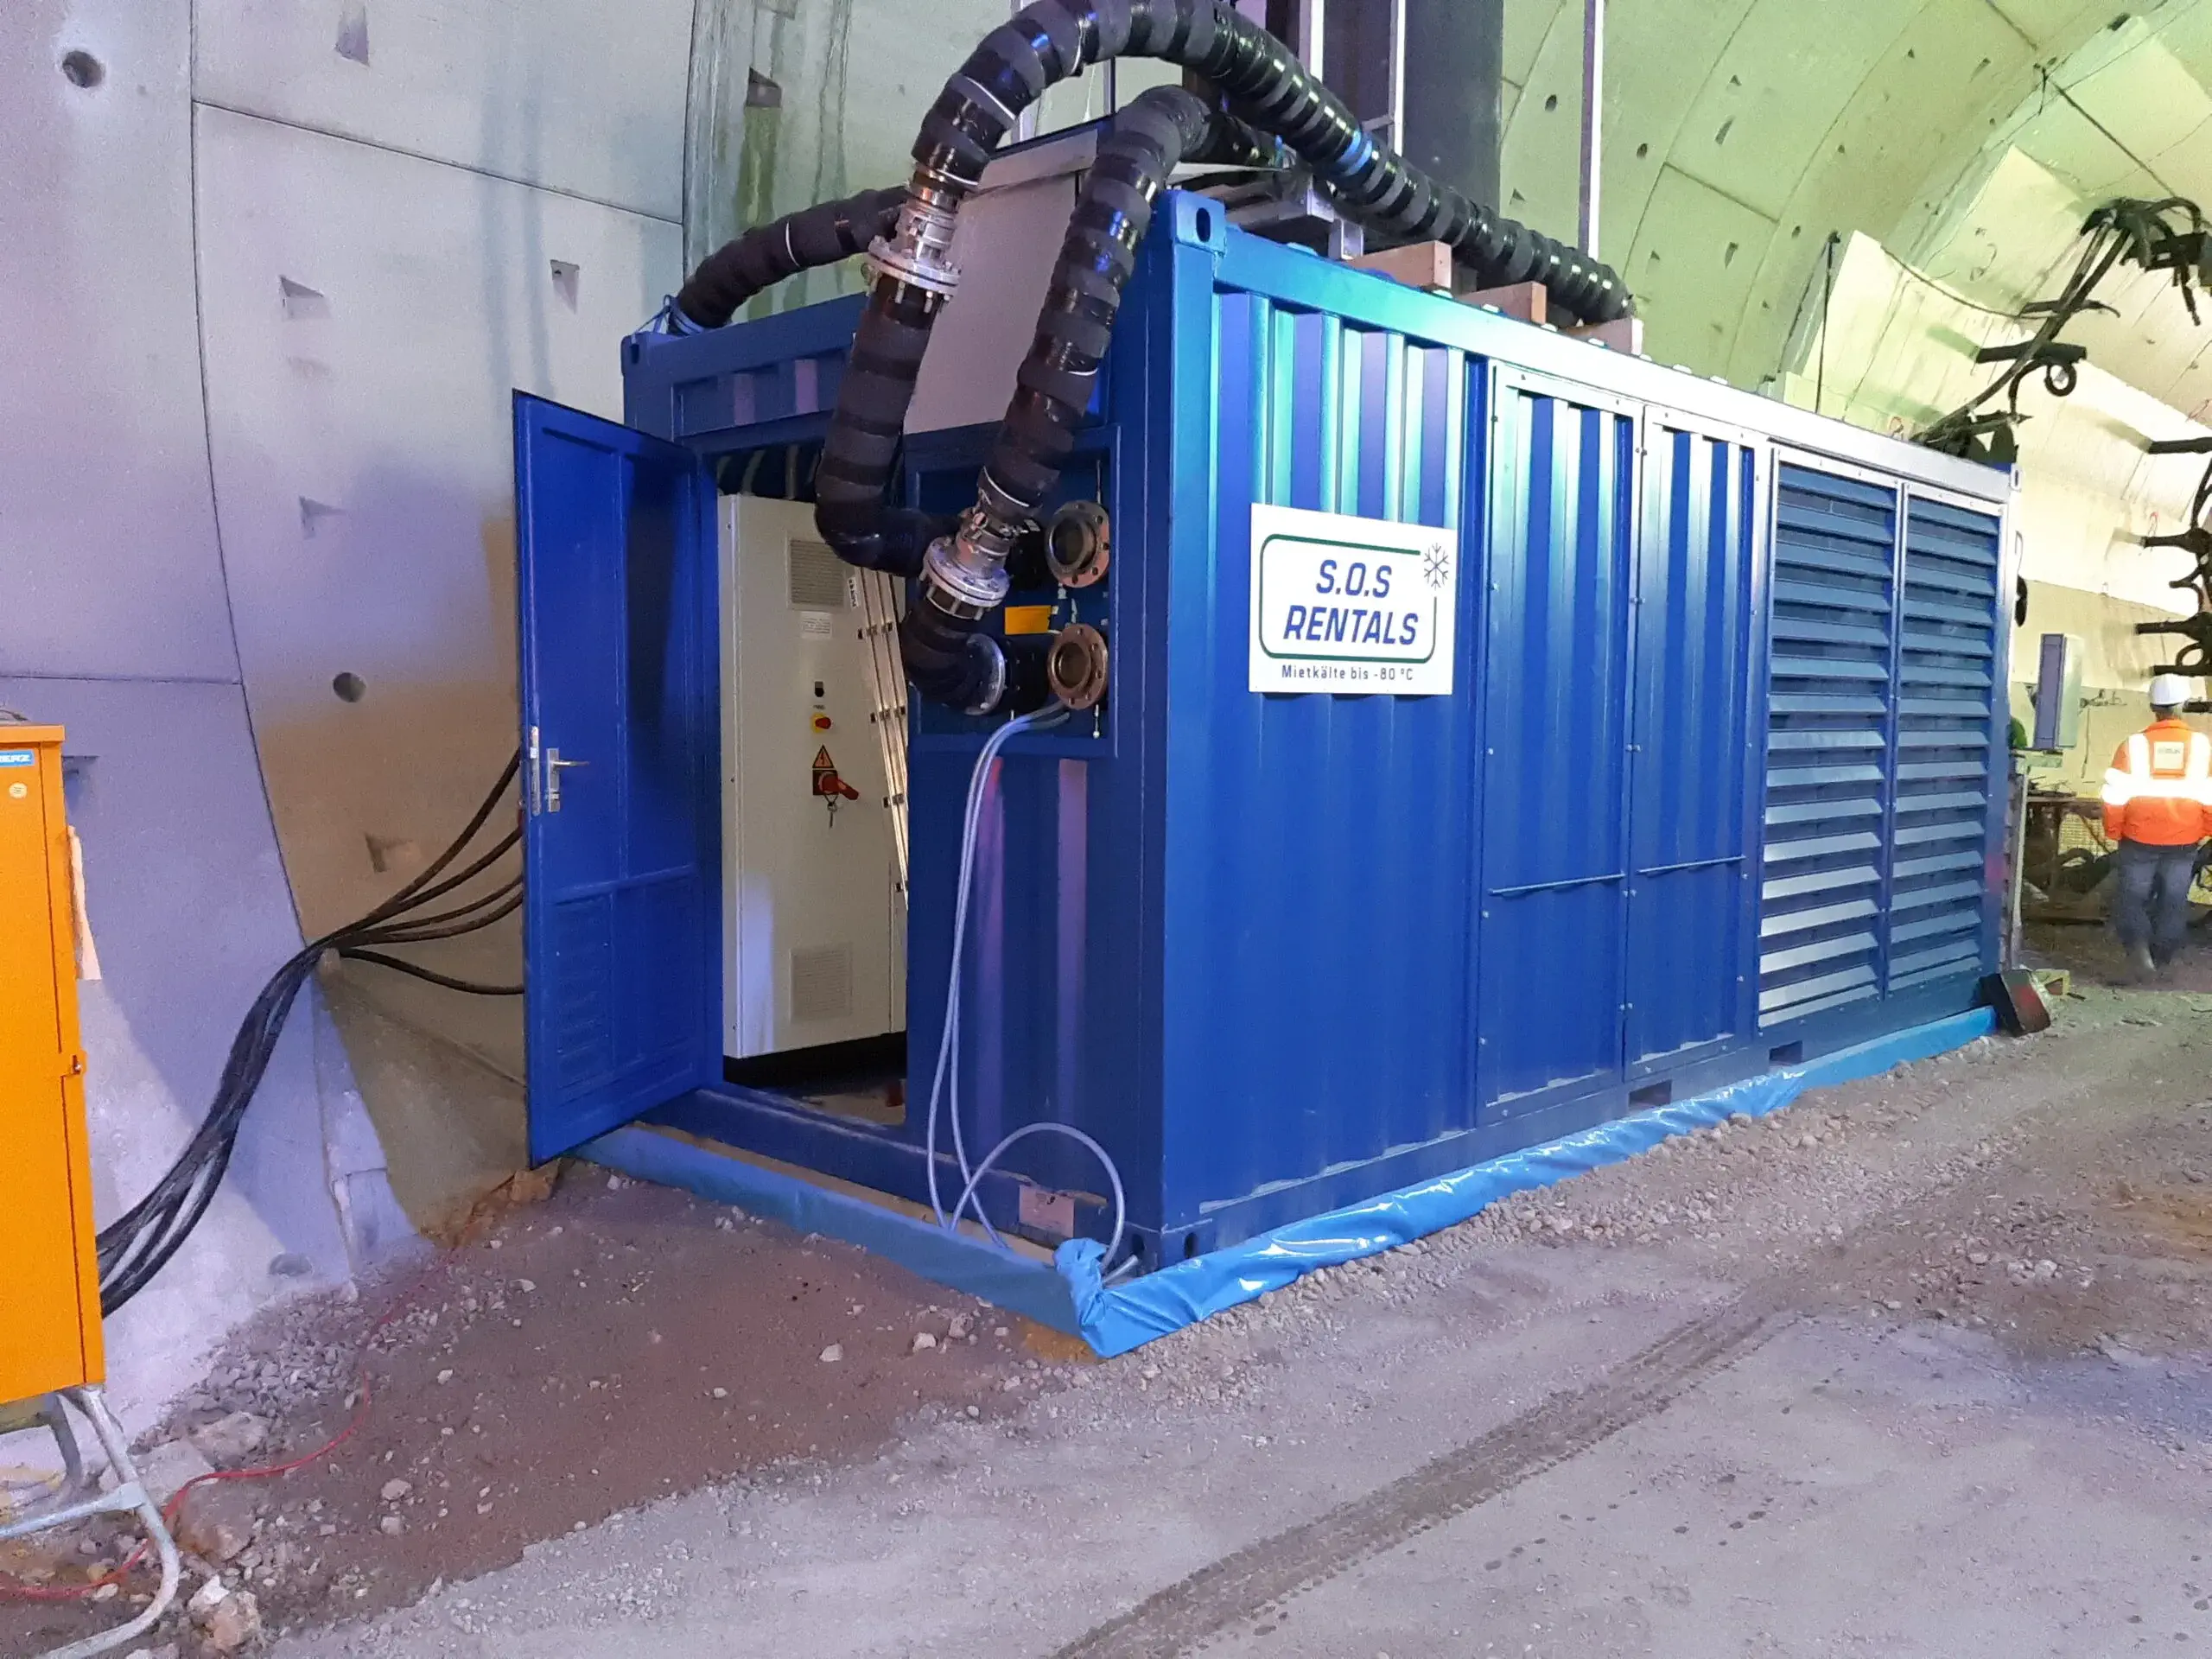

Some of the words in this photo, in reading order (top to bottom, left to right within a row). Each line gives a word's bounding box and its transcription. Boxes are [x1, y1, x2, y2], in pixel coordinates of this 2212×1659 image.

[1316, 559, 1392, 598] S.O.S
[1283, 605, 1419, 645] RENTALS
[1281, 664, 1345, 679] Mietkälte
[1351, 667, 1369, 679] bis
